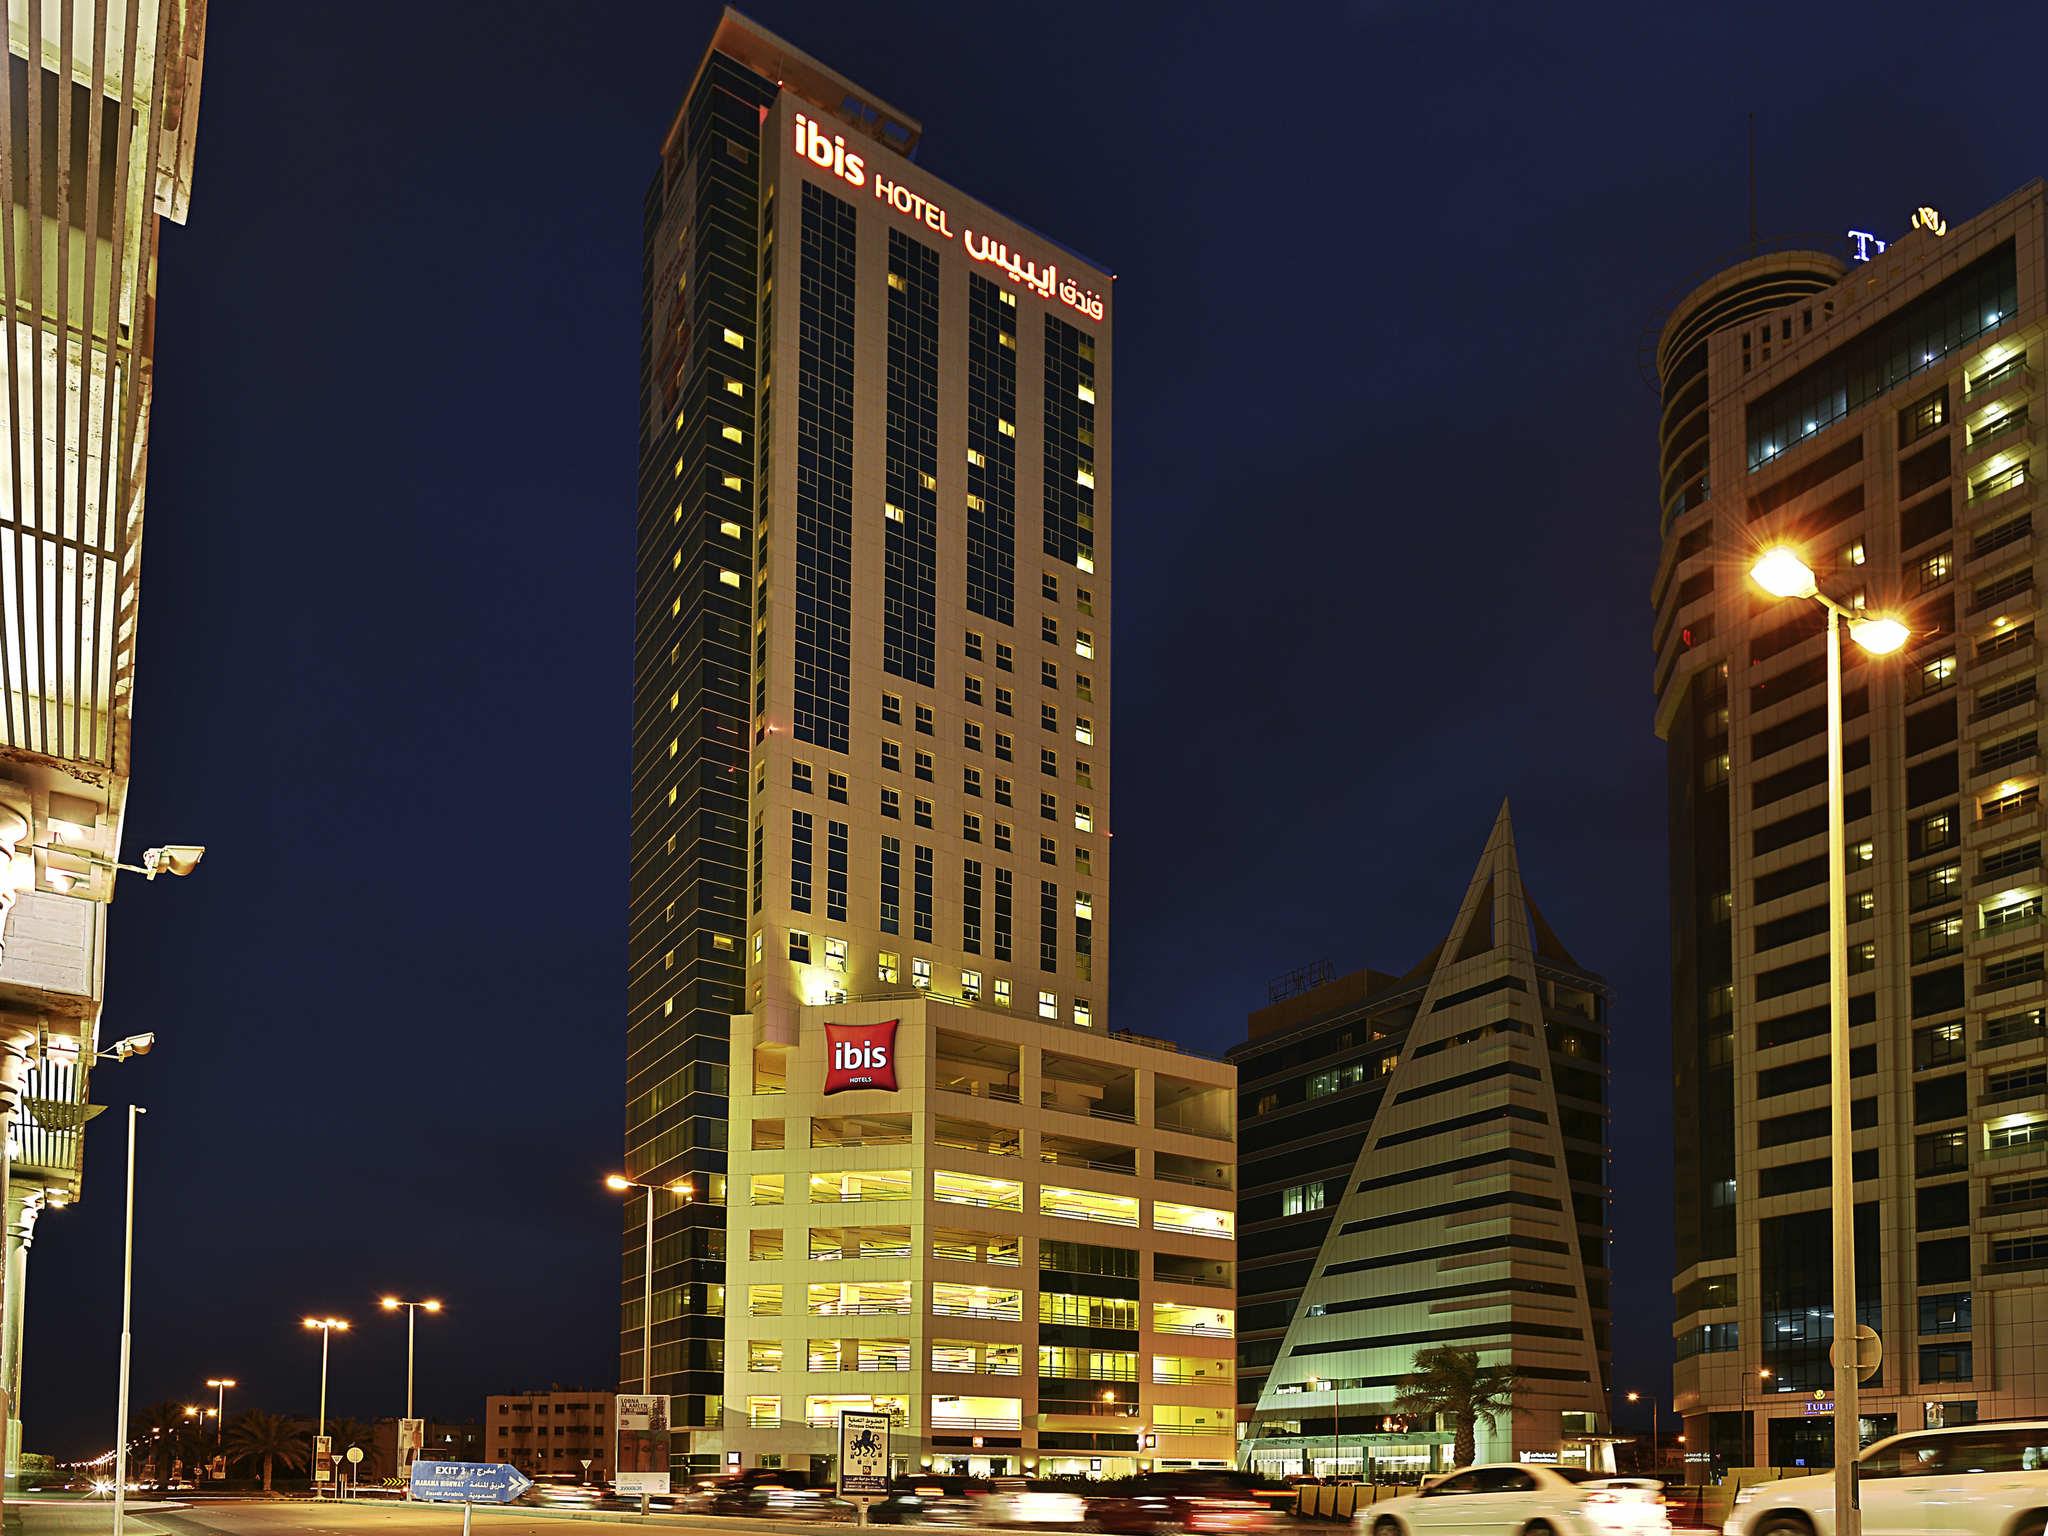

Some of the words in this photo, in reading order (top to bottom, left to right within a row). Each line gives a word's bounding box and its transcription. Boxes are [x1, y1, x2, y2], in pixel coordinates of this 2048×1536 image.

[794, 113, 864, 187] ibis
[874, 173, 954, 239] HOTEL
[1058, 276, 1105, 323] فندق
[835, 1040, 888, 1071] ibis
[849, 1076, 873, 1084] HOTELS
[1805, 1402, 1835, 1411] TULIP
[435, 1466, 458, 1475] EXIT
[476, 1467, 497, 1477] مخرج
